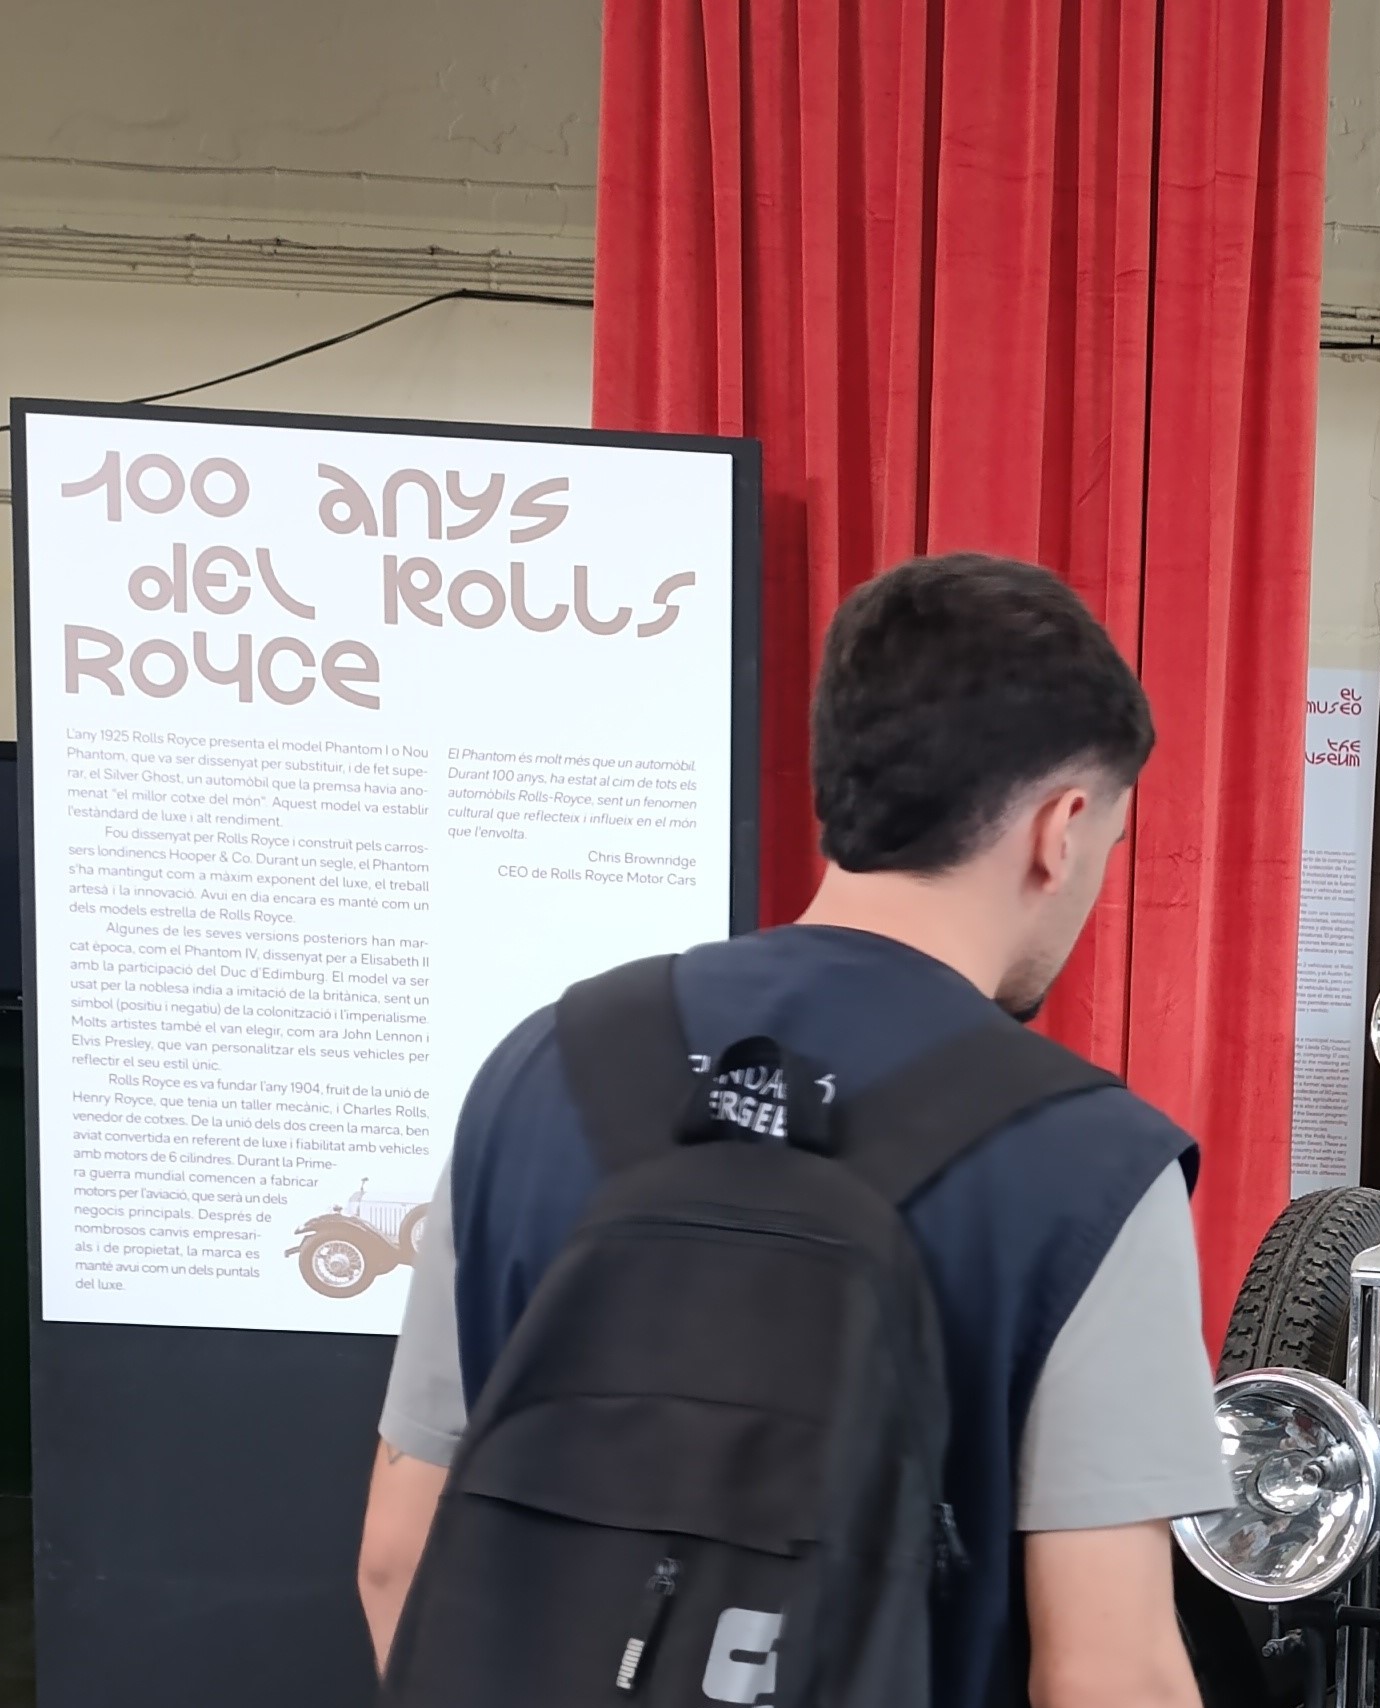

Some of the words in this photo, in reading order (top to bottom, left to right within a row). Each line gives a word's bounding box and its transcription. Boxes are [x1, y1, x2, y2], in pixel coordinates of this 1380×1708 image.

[61, 450, 250, 522] 100
[318, 463, 570, 544] anys
[100, 729, 130, 742] 1925
[132, 730, 164, 744] Rolls
[167, 732, 206, 748] Royce
[209, 737, 265, 749] presenta
[267, 738, 279, 750] el
[281, 740, 322, 752] model
[325, 740, 383, 755] Phantom
[402, 745, 429, 758] Nou
[447, 747, 460, 760] El
[461, 748, 516, 762] Phantom
[534, 753, 562, 765] molt
[592, 757, 616, 770] que
[617, 759, 633, 768] un
[447, 766, 490, 780] Durant
[492, 769, 515, 782] 100
[516, 773, 547, 786] anys,
[549, 772, 565, 784] ha
[567, 775, 597, 786] estat
[598, 775, 610, 787] al
[612, 778, 635, 787] cim
[636, 777, 653, 789] de
[655, 778, 677, 790] tots
[679, 779, 697, 791] els
[517, 789, 594, 807] Rolls-Royce,
[597, 796, 624, 806] sent
[625, 798, 641, 807] un
[643, 796, 697, 809] fenomen
[447, 806, 494, 819] cultural
[496, 810, 520, 822] que
[523, 809, 580, 823] reflecteix
[589, 813, 634, 826] influeix
[636, 817, 652, 827] en
[654, 816, 667, 827] el
[447, 827, 472, 839] que
[68, 846, 95, 856] sers
[97, 845, 167, 859] londinencs
[169, 848, 217, 864] Hooper
[231, 851, 253, 864] Co.
[256, 852, 299, 866] Durant
[301, 858, 317, 867] un
[319, 857, 356, 872] segle,
[358, 858, 370, 870] el
[372, 858, 429, 872] Phantom
[587, 850, 621, 864] Chris
[624, 852, 696, 870] Brownridge
[497, 864, 528, 878] CEO
[531, 867, 548, 879] de
[550, 867, 582, 880] Rolls
[584, 869, 624, 884] Royce
[626, 871, 664, 884] Motor
[666, 872, 696, 886] Cars
[68, 901, 96, 914] dels
[99, 904, 147, 916] models
[149, 906, 197, 919] estrella
[199, 908, 216, 920] de
[219, 908, 251, 921] Rolls
[253, 909, 296, 926] Royce.
[105, 921, 159, 938] Algunes
[162, 924, 179, 937] de
[183, 925, 202, 938] les
[205, 929, 242, 940] seves
[245, 931, 300, 943] versions
[303, 933, 368, 946] posteriors
[371, 935, 395, 947] han
[399, 939, 428, 949] mar-
[71, 1033, 101, 1047] Elvis
[104, 1035, 154, 1052] Presley,
[157, 1040, 182, 1052] que
[185, 1042, 208, 1051] van
[211, 1043, 294, 1055] personalitzar
[297, 1045, 316, 1057] els
[320, 1048, 350, 1059] seus
[353, 1048, 405, 1061] vehicles
[408, 1052, 430, 1064] per
[72, 1091, 111, 1106] Henry
[114, 1092, 156, 1108] Royce,
[159, 1097, 184, 1109] que
[187, 1097, 218, 1108] tenia
[221, 1100, 237, 1109] un
[240, 1099, 272, 1111] taller
[342, 1102, 392, 1116] Charles
[395, 1105, 429, 1119] Rolls,
[73, 1130, 102, 1141] aviat
[104, 1132, 171, 1144] convertida
[173, 1135, 189, 1144] en
[191, 1133, 241, 1147] referent
[242, 1136, 259, 1148] de
[261, 1137, 287, 1149] luxe
[295, 1138, 346, 1152] fiabilitat
[347, 1141, 377, 1153] amb
[378, 1142, 430, 1155] vehicles
[73, 1168, 86, 1178] ra
[89, 1169, 131, 1181] guerra
[134, 1170, 185, 1182] mundial
[188, 1173, 256, 1184] comencen
[270, 1174, 319, 1187] fabricar
[73, 1205, 125, 1219] negocis
[128, 1207, 194, 1220] principals.
[255, 1211, 272, 1223] de
[74, 1241, 93, 1252] als
[103, 1242, 120, 1254] de
[123, 1245, 183, 1257] propietat,
[186, 1245, 198, 1257] la
[201, 1248, 242, 1259] marca
[245, 1250, 260, 1259] es
[75, 1277, 95, 1289] del
[97, 1278, 127, 1291] luxe.
